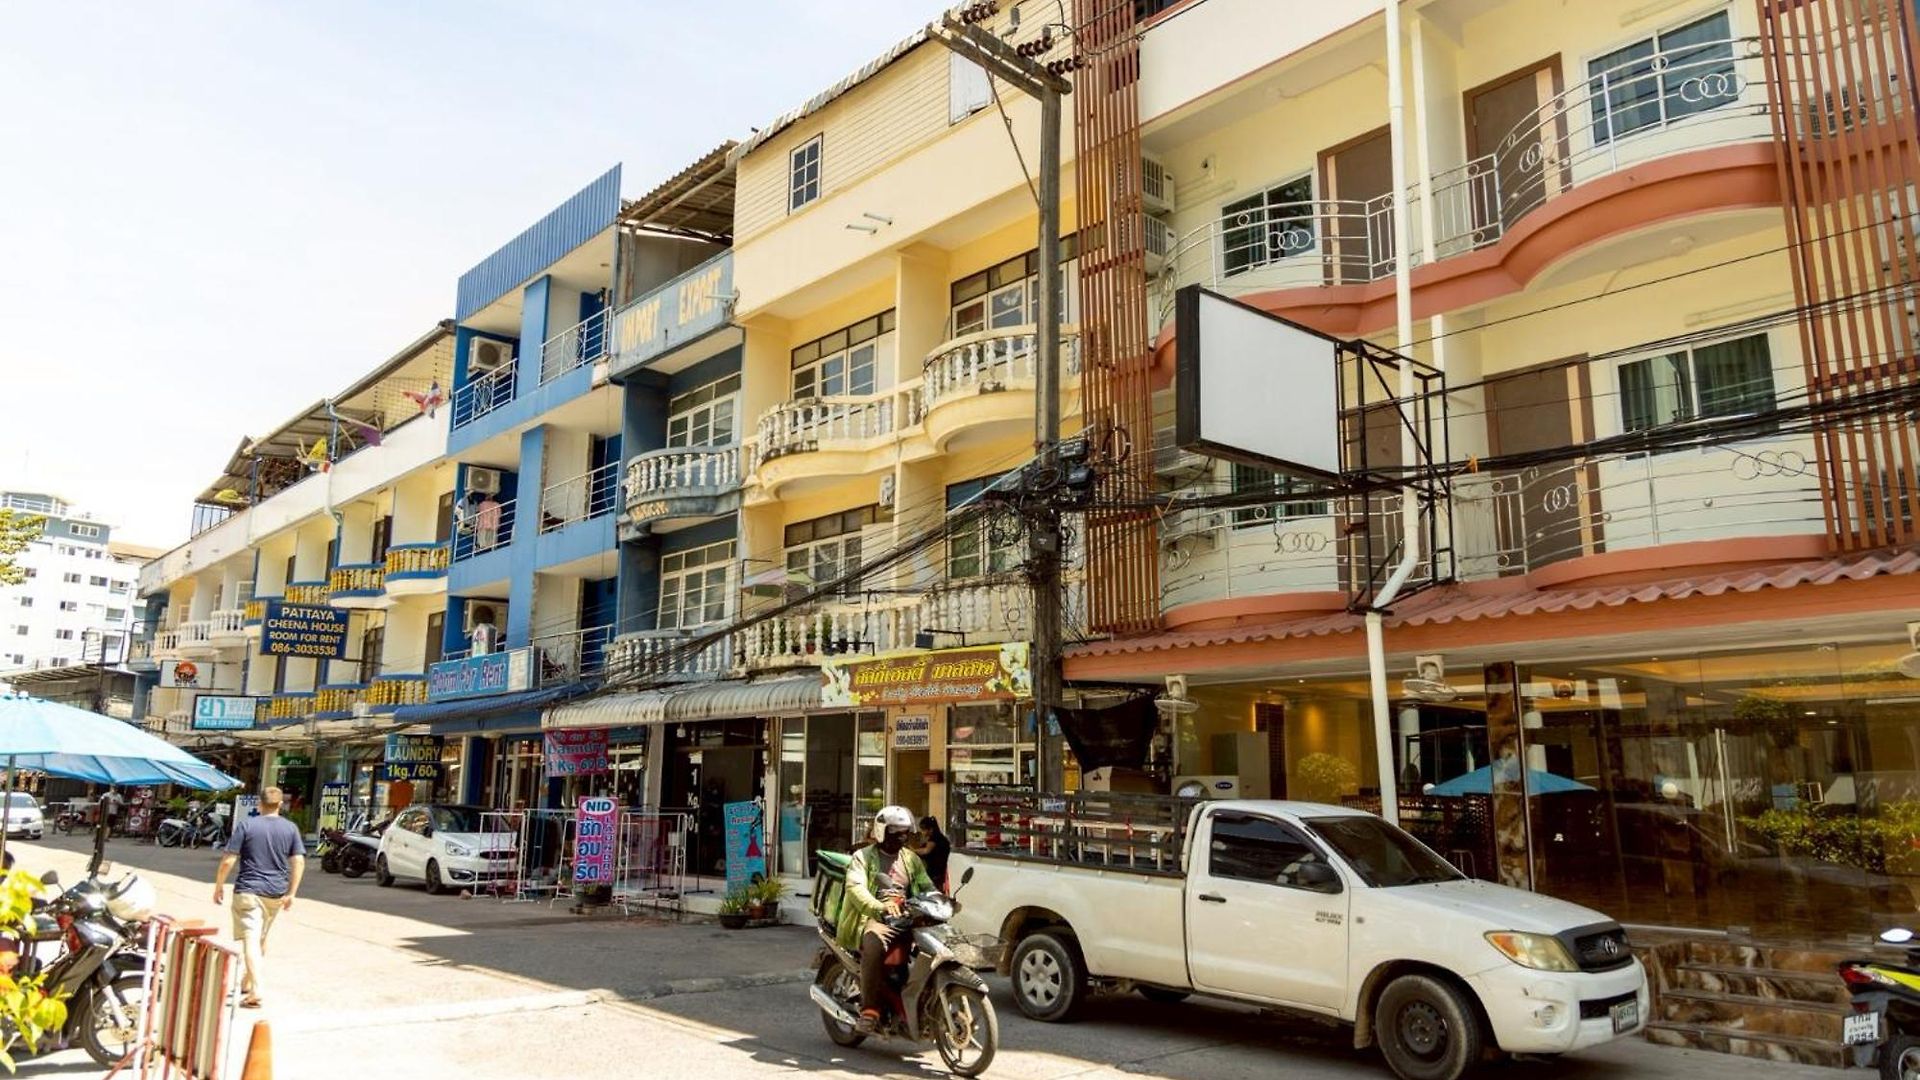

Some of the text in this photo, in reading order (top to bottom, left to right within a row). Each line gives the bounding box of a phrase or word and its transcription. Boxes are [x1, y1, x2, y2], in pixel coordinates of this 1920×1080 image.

[281, 607, 335, 621] PATTAYA
[268, 618, 345, 633] CHEENA HOUSE
[269, 631, 341, 644] ROOM FOR RENT
[430, 667, 461, 696] Room
[481, 657, 507, 690] Rent
[387, 745, 440, 761] LAUNDRY
[547, 743, 606, 757] Laundry
[557, 760, 576, 774] Kg
[586, 801, 612, 812] NID
[579, 817, 602, 836] ซัก
[578, 842, 601, 856] อบ
[604, 816, 615, 879] LAUNDRY
[576, 860, 599, 880] รีด
